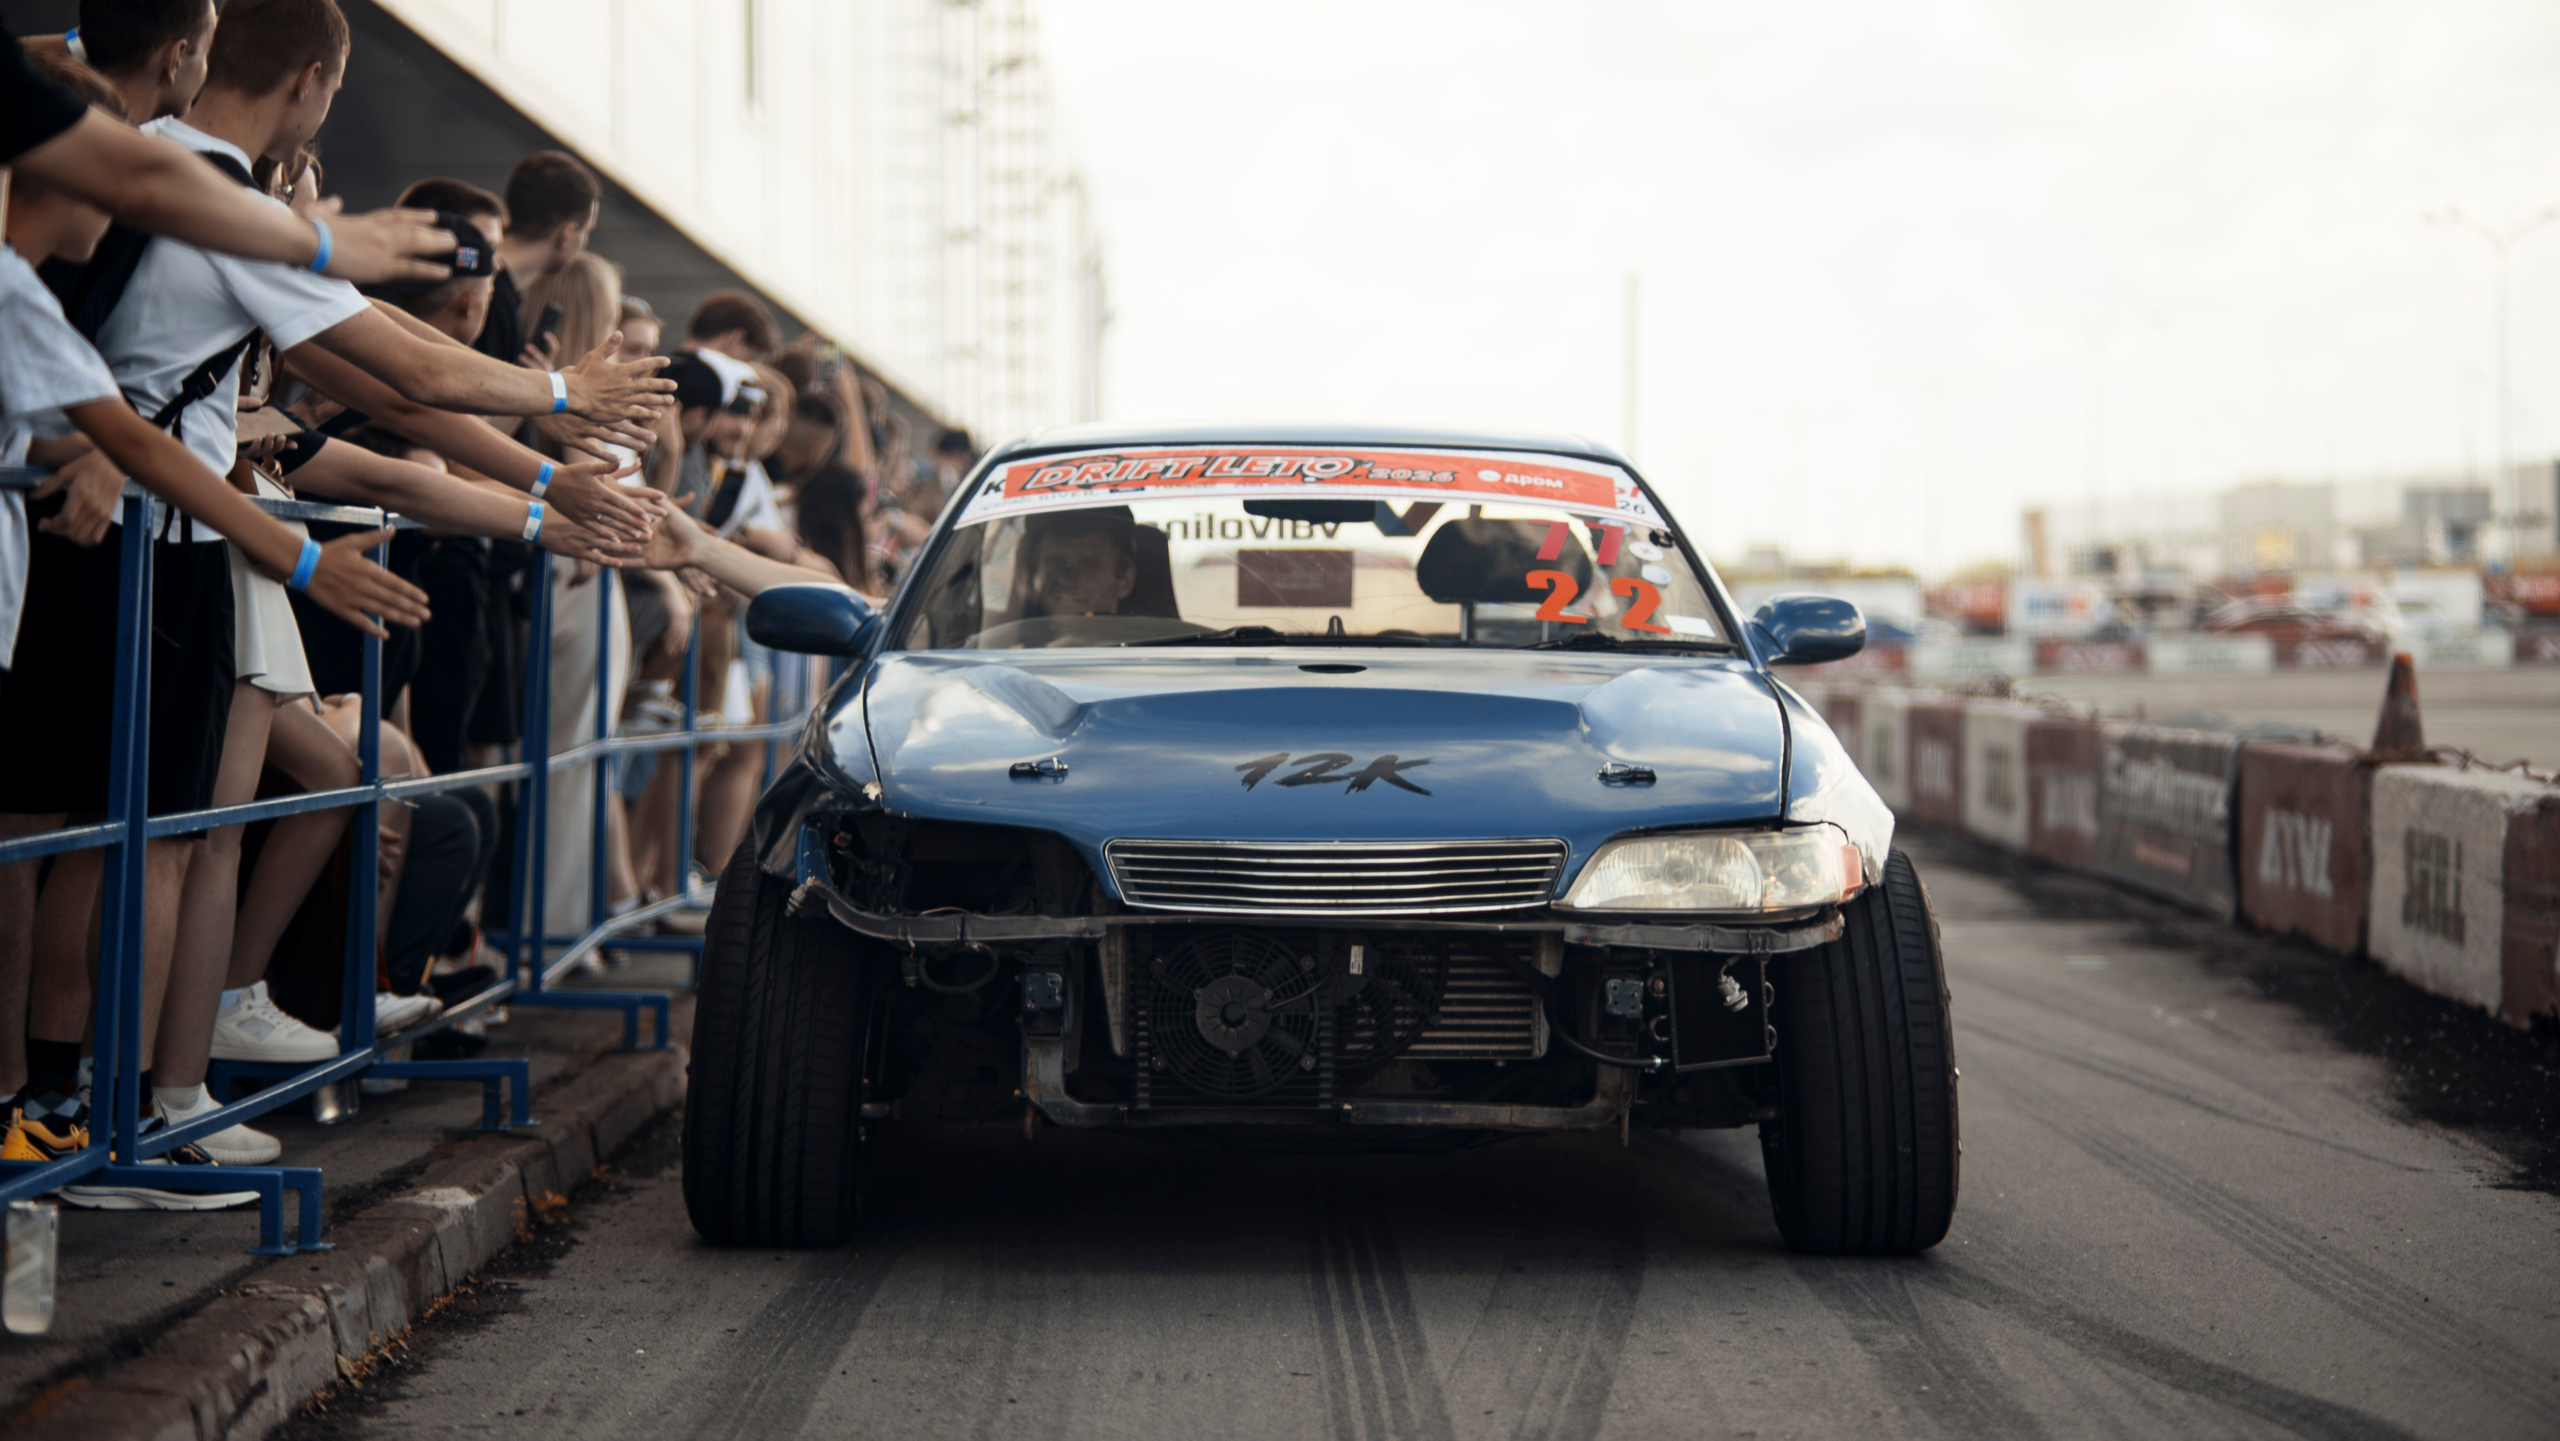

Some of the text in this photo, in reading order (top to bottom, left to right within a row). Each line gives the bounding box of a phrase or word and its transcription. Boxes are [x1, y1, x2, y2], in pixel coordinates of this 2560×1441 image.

[1021, 456, 1210, 490] DRIFT
[1366, 467, 1457, 483] 2026
[1234, 752, 1436, 797] 12K
